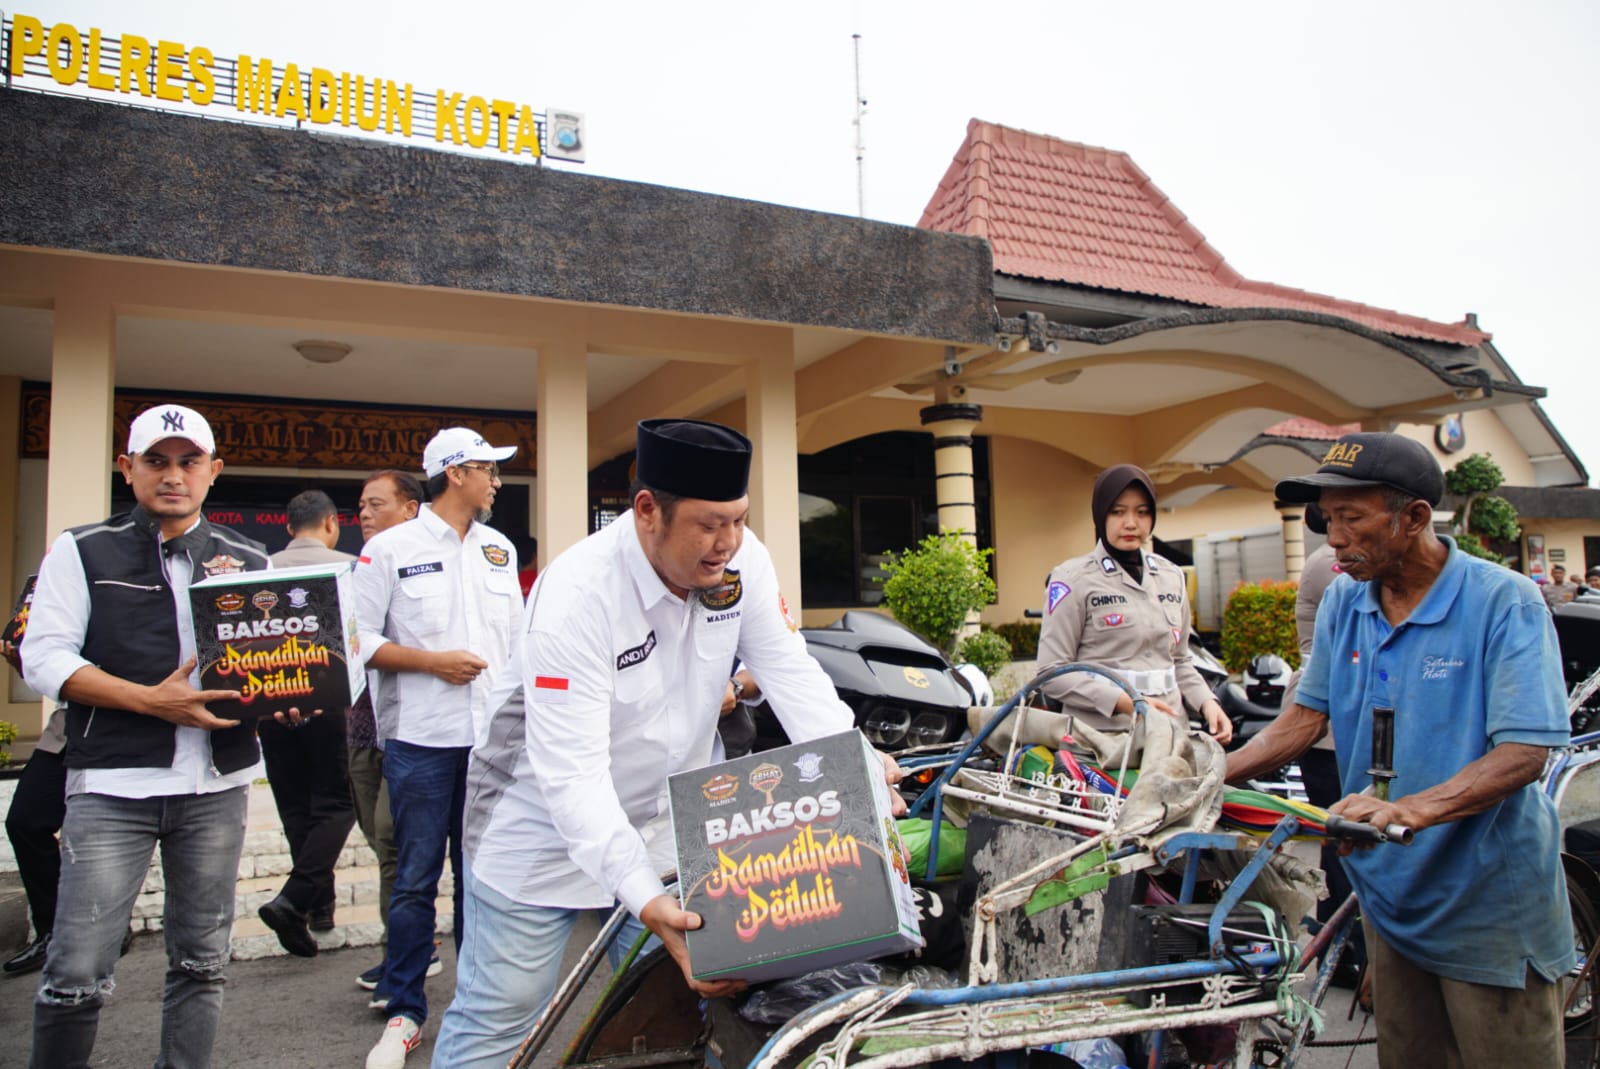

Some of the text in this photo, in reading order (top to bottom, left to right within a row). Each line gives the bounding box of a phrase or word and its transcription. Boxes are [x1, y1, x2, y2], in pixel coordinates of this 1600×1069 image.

[11, 13, 541, 157] POLRES MADIUN KOTA
[160, 411, 185, 432] NY
[208, 511, 244, 525] KOTA
[406, 564, 436, 576] FAIZAL
[216, 615, 320, 642] BAKSOS
[706, 611, 741, 624] MADIUN
[216, 635, 330, 677] Ramadhan
[619, 649, 645, 667] ANDI
[705, 790, 842, 846] BAKSOS
[705, 824, 863, 900] Ramadhan
